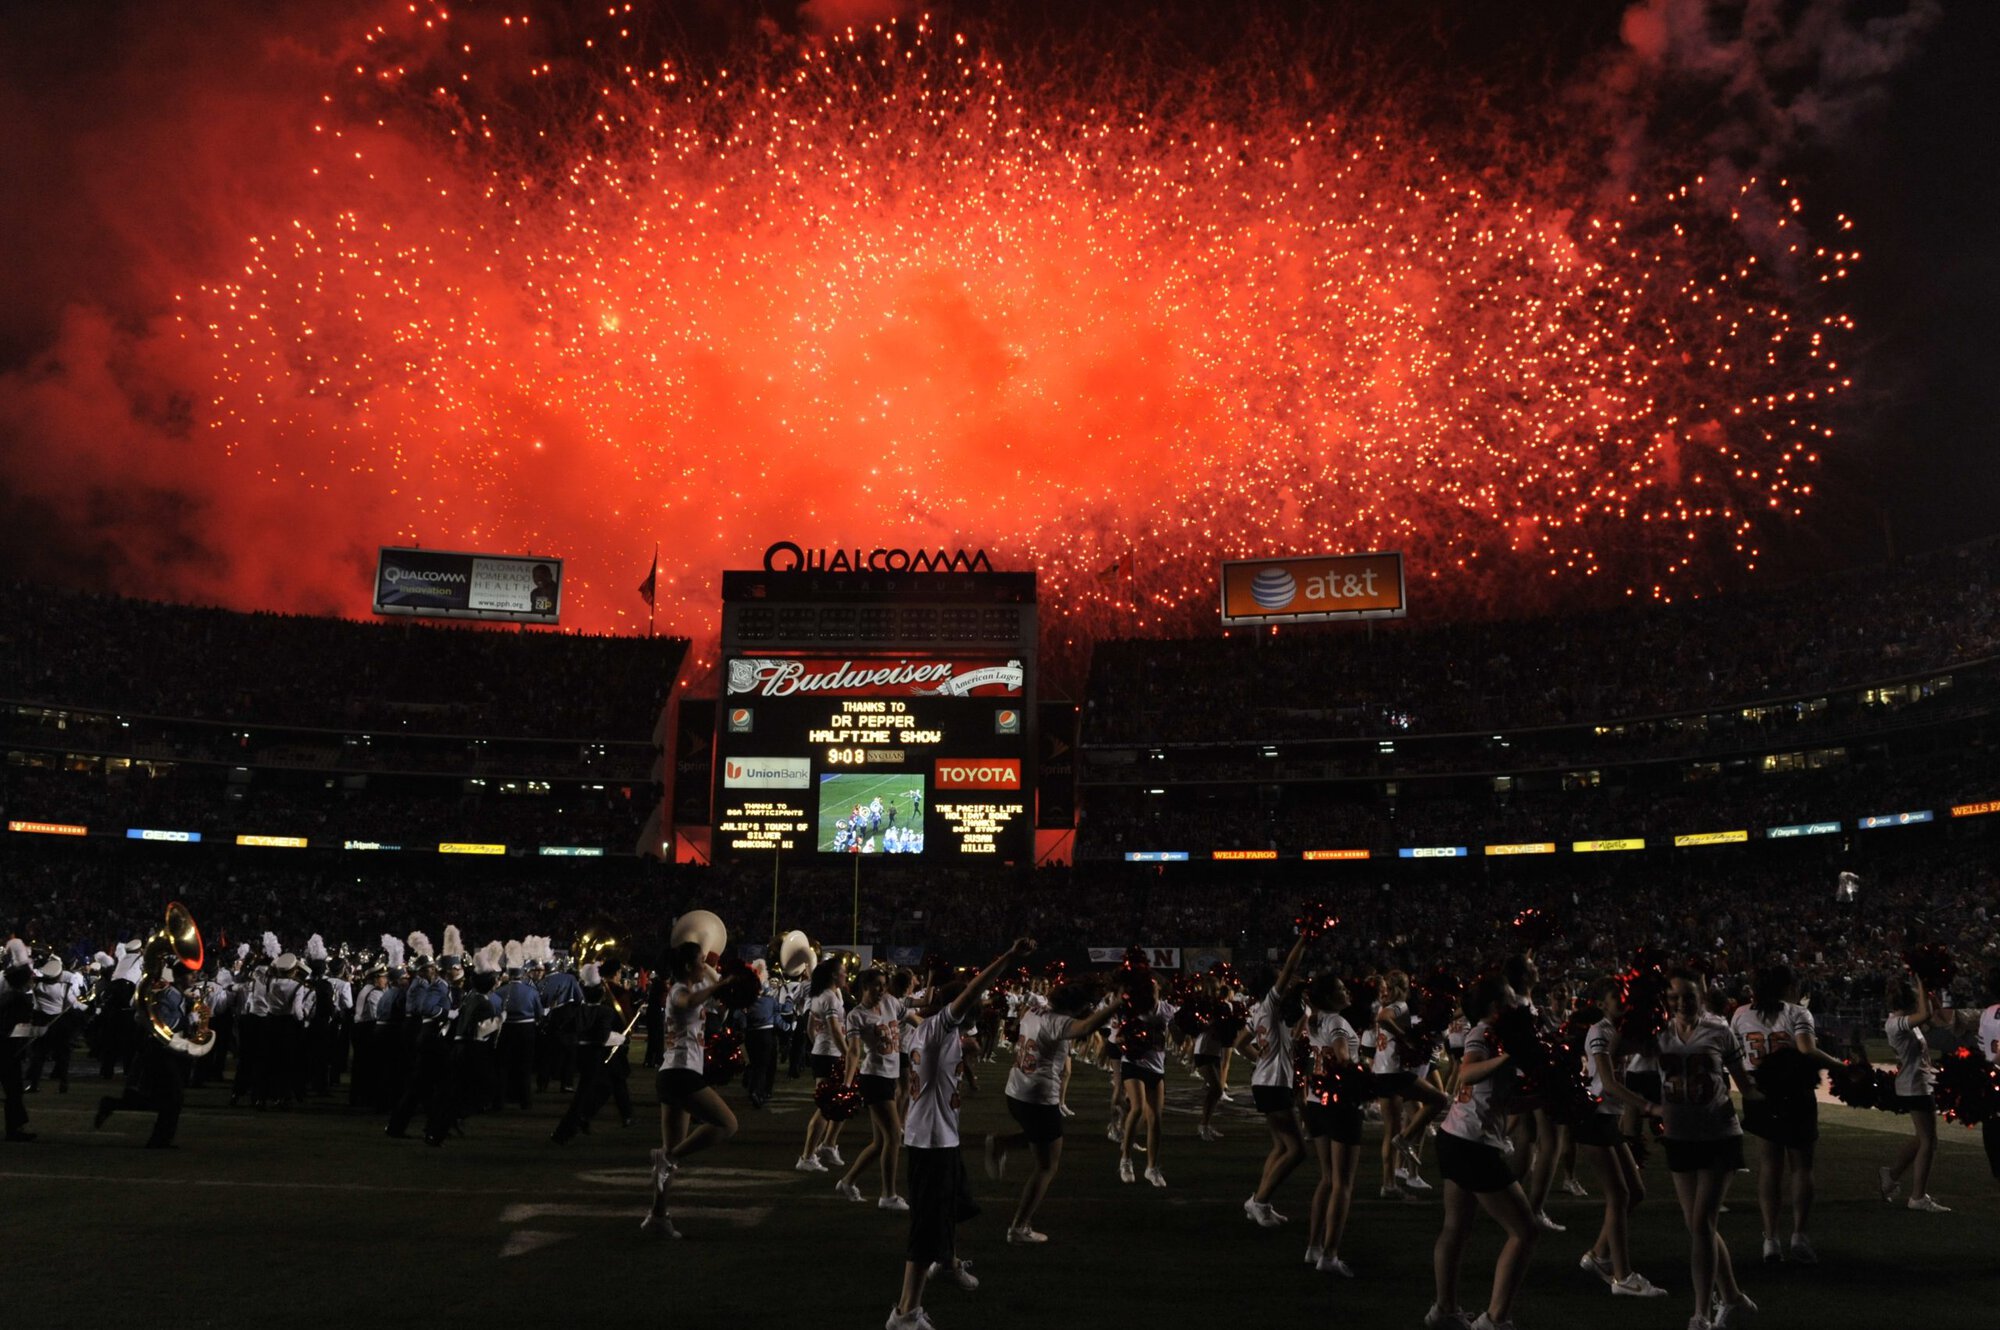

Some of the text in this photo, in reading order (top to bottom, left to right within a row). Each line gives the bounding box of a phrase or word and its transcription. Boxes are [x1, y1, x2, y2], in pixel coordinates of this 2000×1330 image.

[763, 541, 993, 573] QUALCOMM
[476, 563, 530, 573] PALOMAR
[384, 567, 466, 584] QUALCOMM
[476, 572, 531, 582] POMERADO
[475, 581, 530, 591] HEALTH
[811, 580, 976, 591] STADIUM
[1305, 568, 1378, 599] at&t
[400, 584, 452, 596] innovation
[478, 600, 524, 609] www.pph.org
[754, 660, 952, 696] Budweiser
[954, 671, 1021, 690] American Lager
[842, 702, 906, 713] THANKS TO
[831, 715, 915, 728] DR PEPPER
[809, 730, 942, 743] HALFTIME SHOW
[868, 752, 904, 760] SYCUAN
[746, 768, 808, 779] UnionBank
[939, 767, 1017, 782] TOYOTA
[745, 809, 804, 817] PARTICIPANTS
[935, 804, 1023, 813] THE PACIFIC LIFE
[1951, 803, 1989, 816] WELLS
[945, 812, 1012, 820] HOLIDAY BOWL
[720, 822, 808, 831] JULIE'S TOUCH OF
[962, 819, 996, 827] THANKS
[1777, 828, 1799, 837] Degree
[1813, 825, 1836, 833] Degree
[142, 830, 189, 841] GEICO
[747, 831, 782, 840] SILVER
[244, 836, 301, 847] CYMER
[961, 844, 996, 853] MILLER
[1412, 847, 1457, 858] GEICO
[1494, 843, 1546, 855] CYMER
[1213, 851, 1277, 860] WELLS FARGO
[1153, 949, 1173, 966] N
